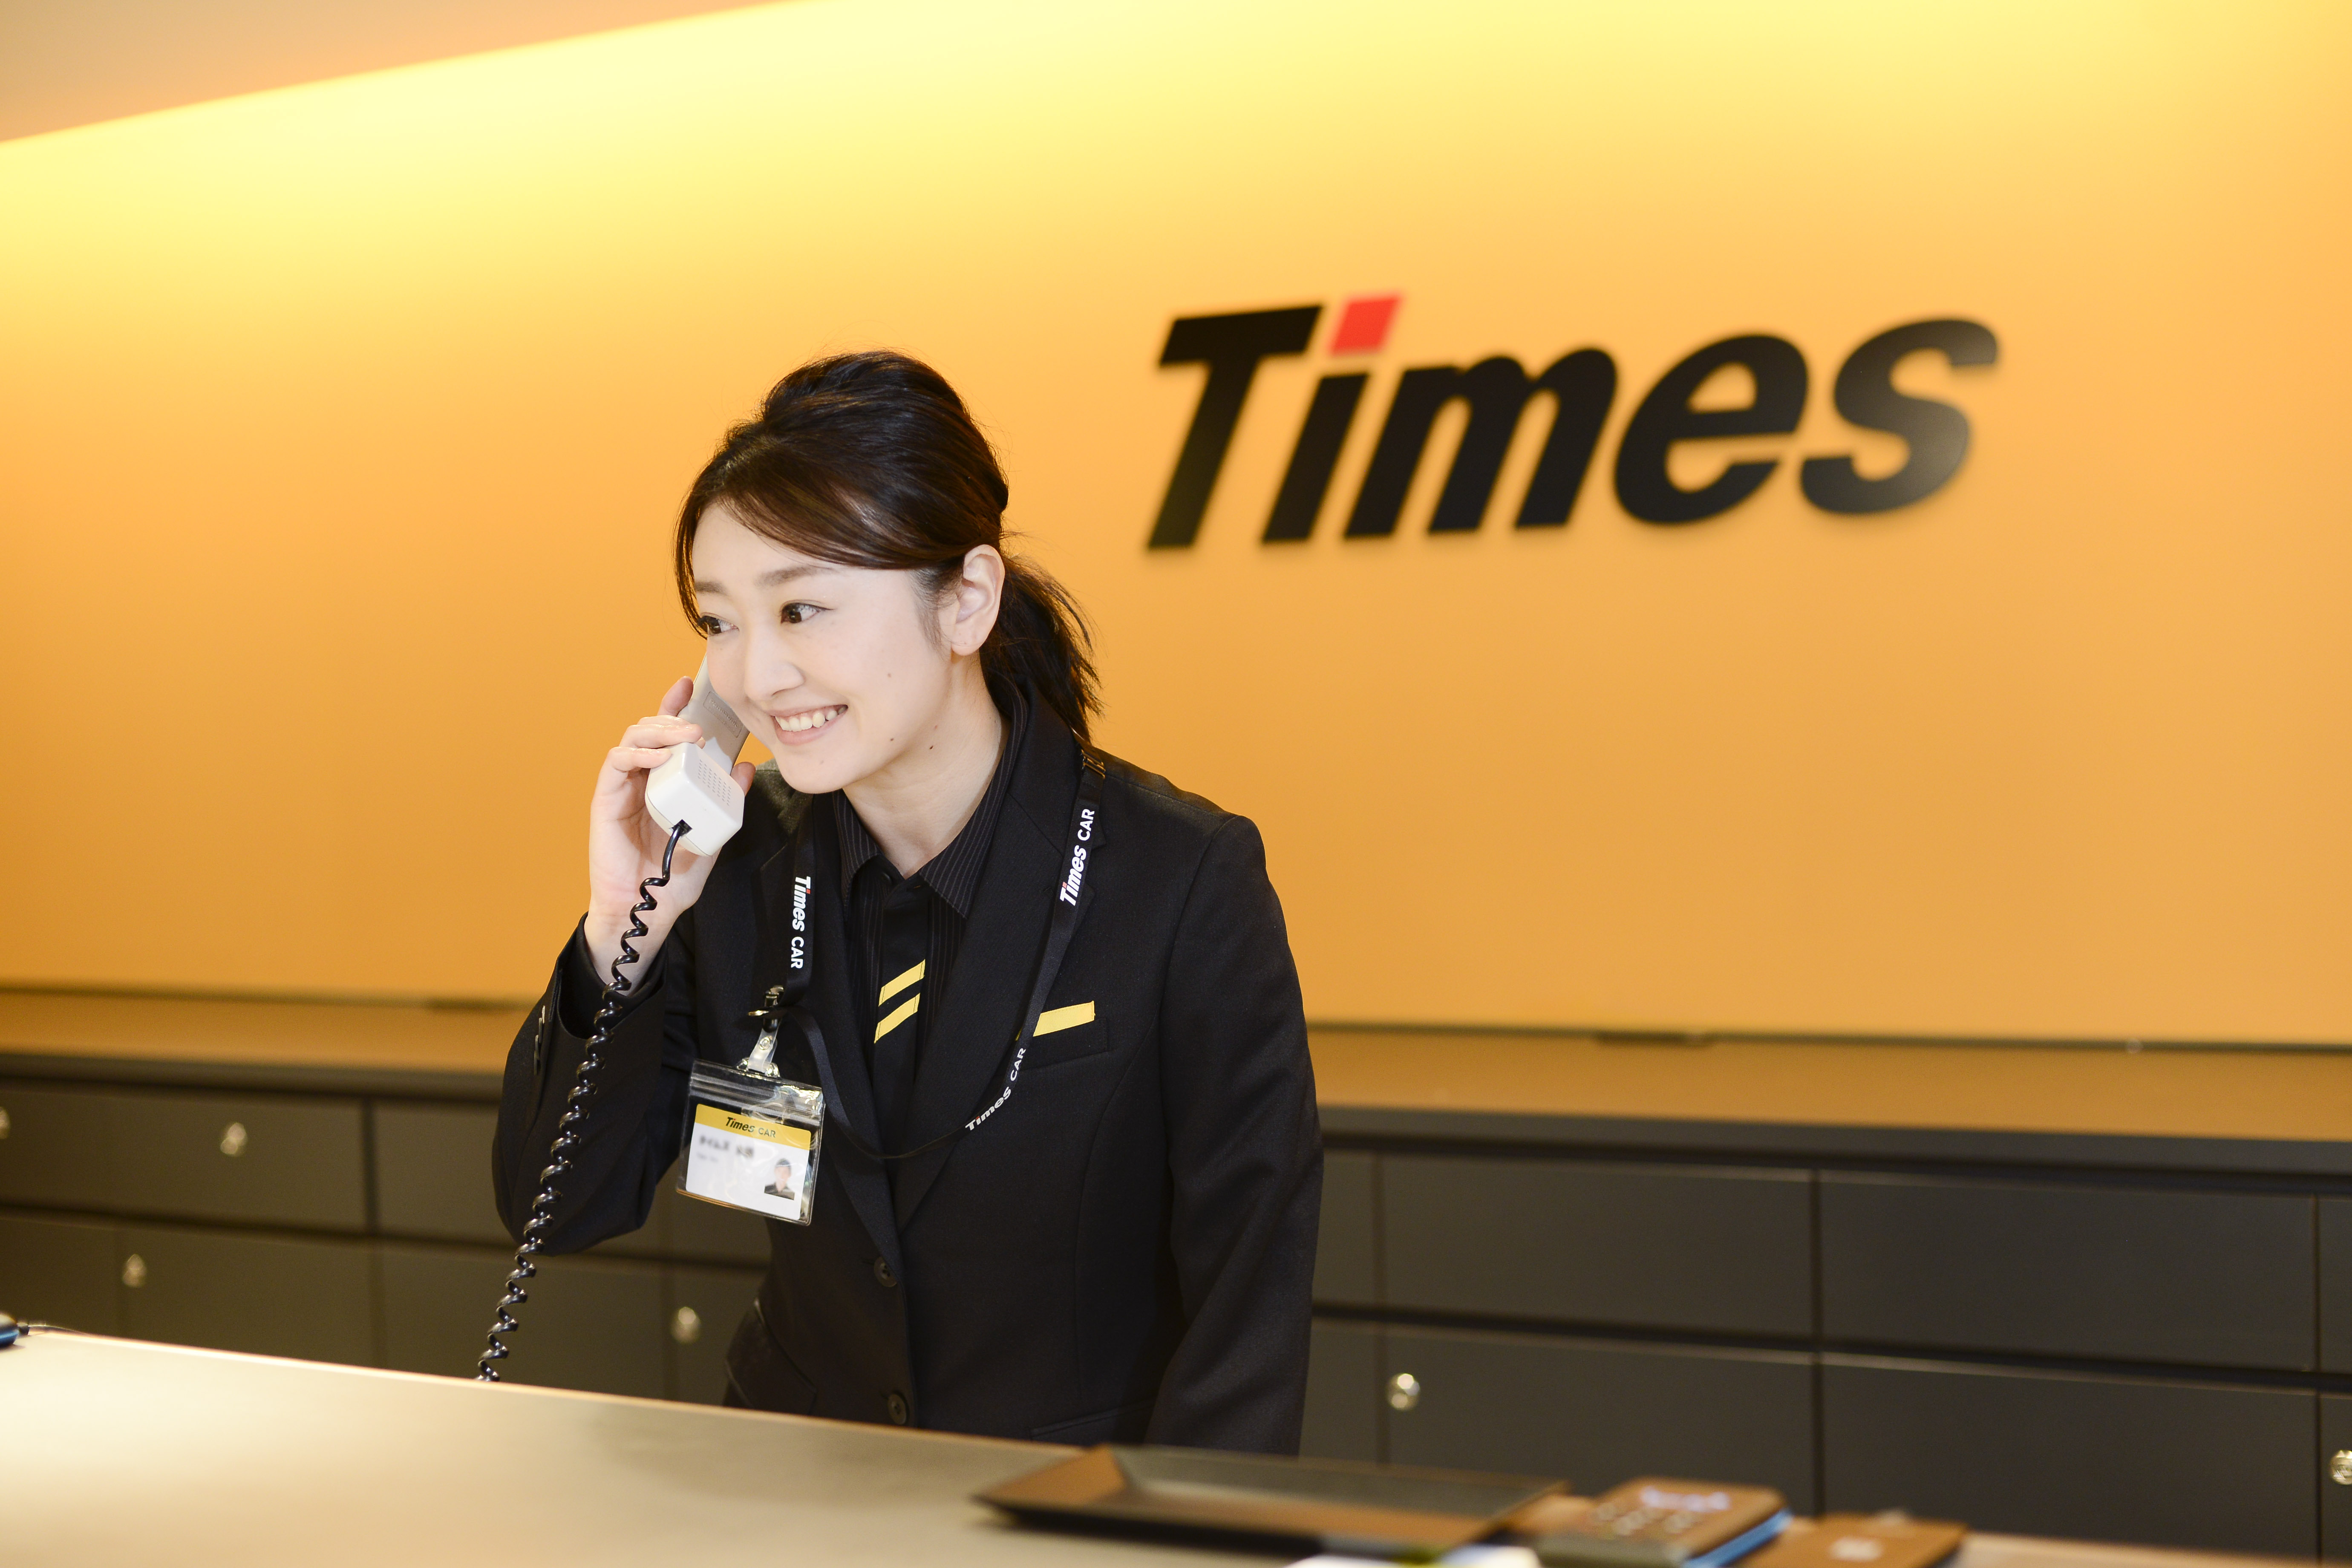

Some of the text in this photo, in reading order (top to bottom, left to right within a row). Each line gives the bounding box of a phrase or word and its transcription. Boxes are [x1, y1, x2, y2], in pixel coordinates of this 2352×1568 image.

[1146, 292, 1999, 550] Times
[1060, 808, 1095, 906] Times CAR
[791, 876, 811, 969] Times CAR
[726, 1116, 776, 1138] Times CAR
[965, 1048, 1026, 1131] Times CAR
